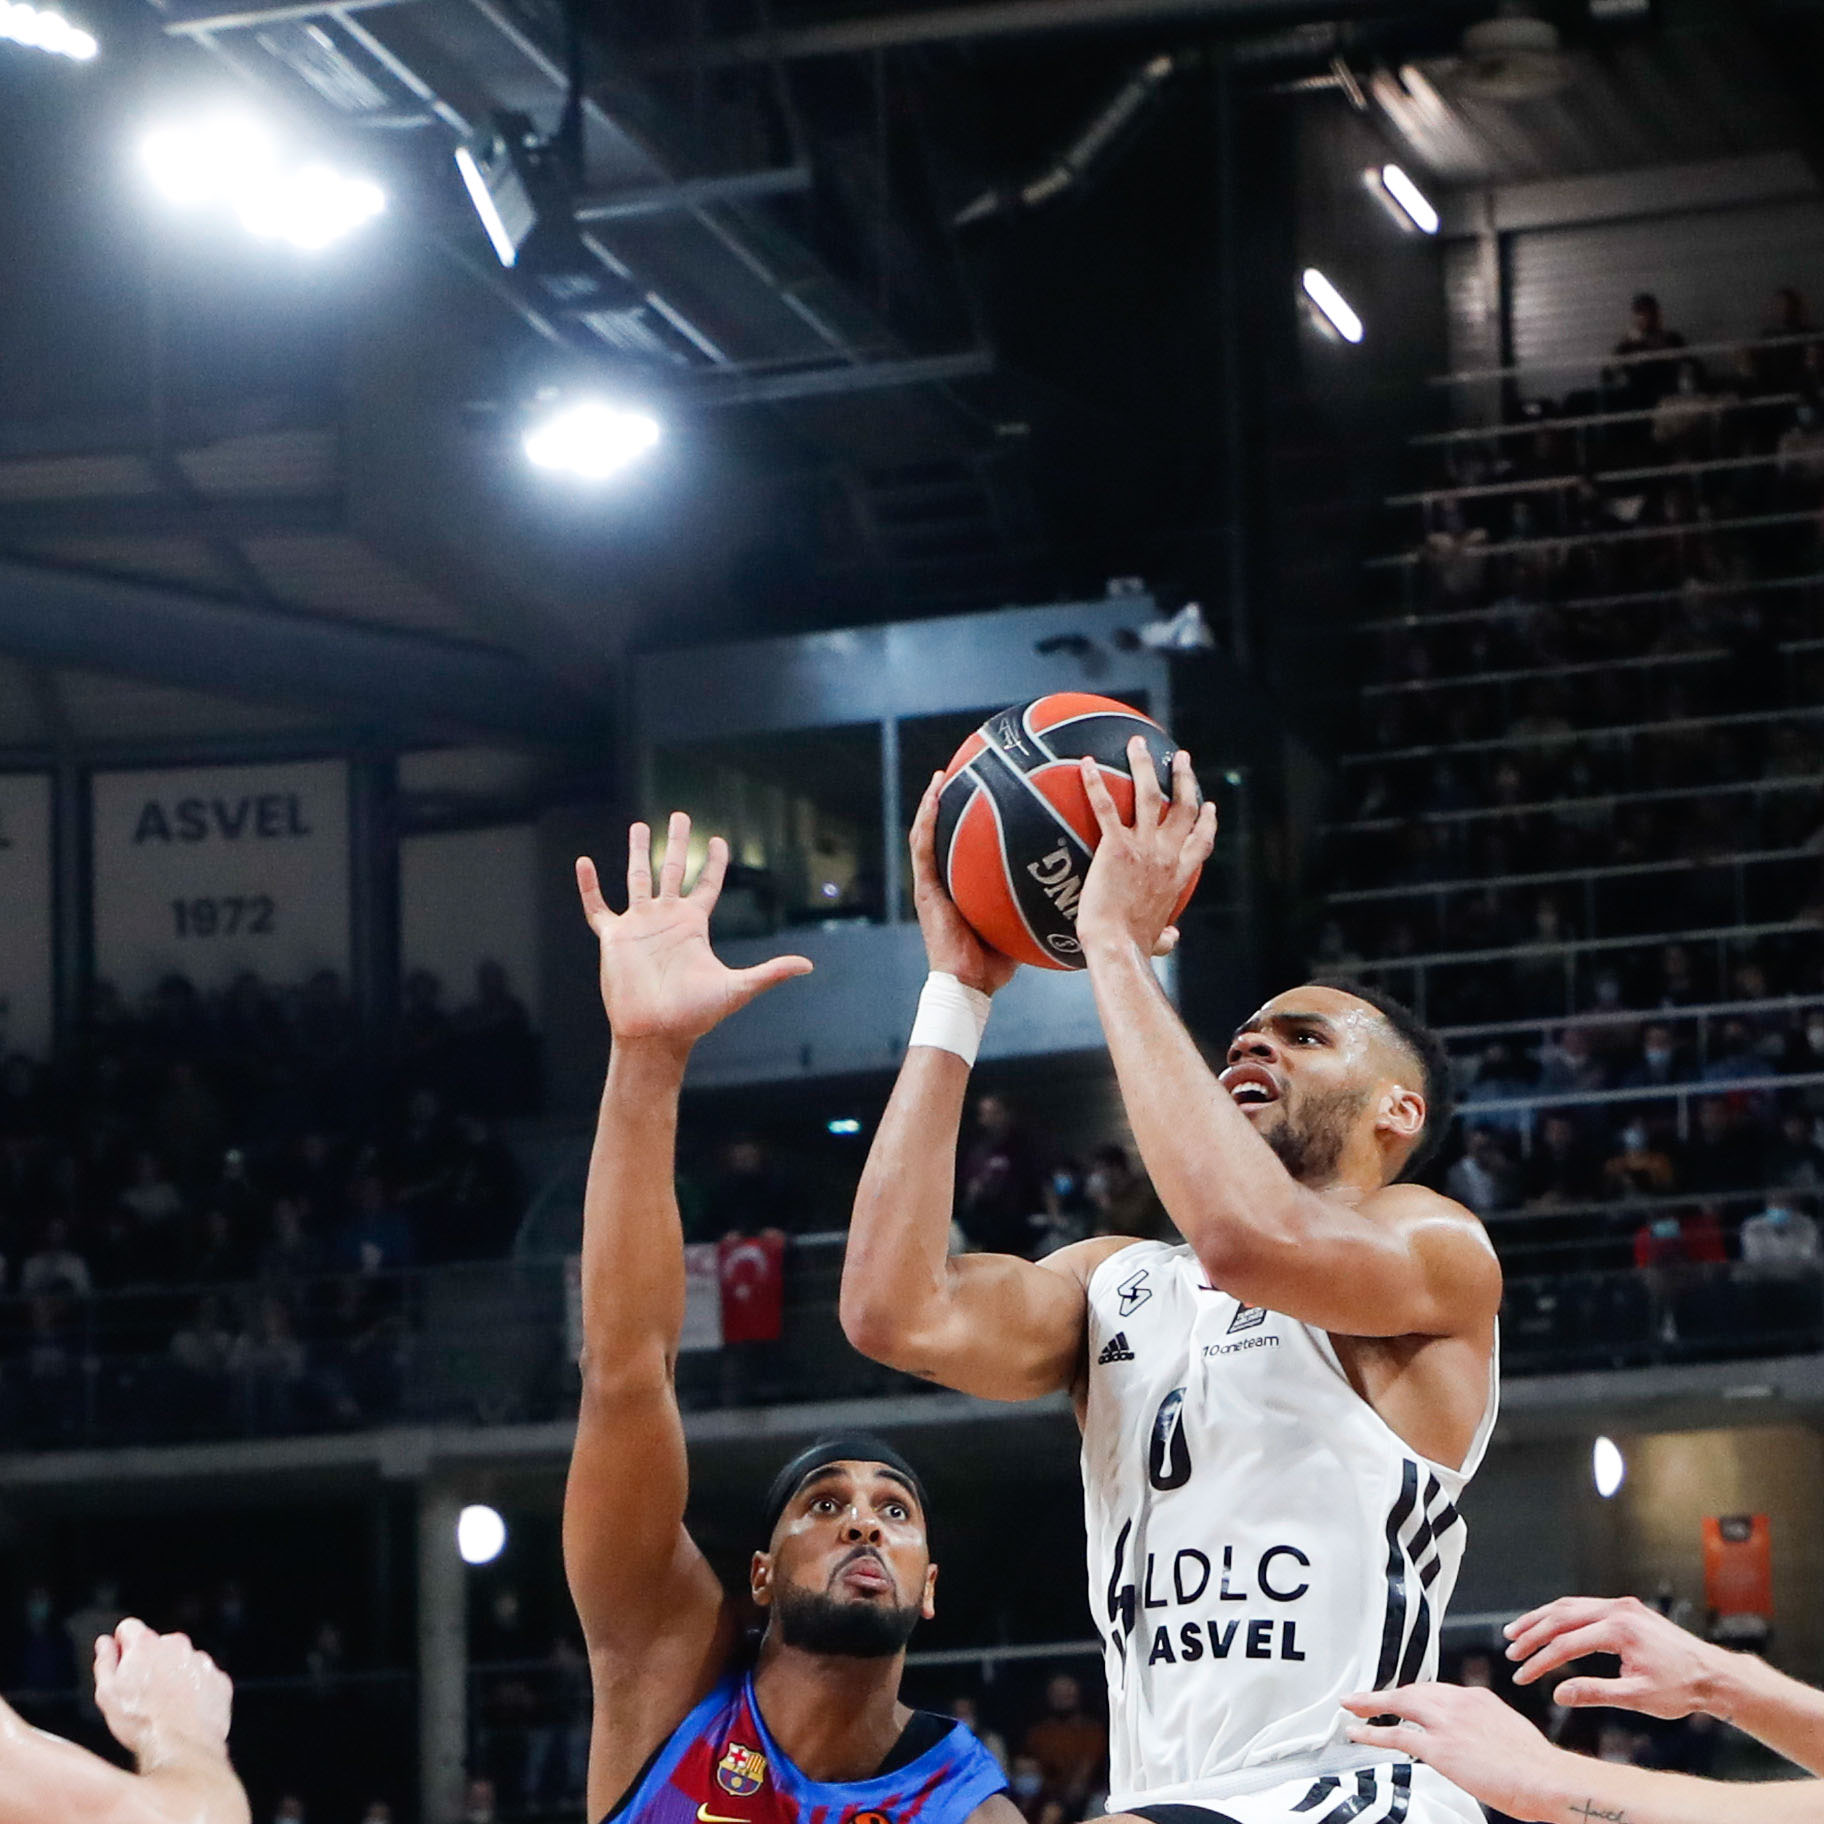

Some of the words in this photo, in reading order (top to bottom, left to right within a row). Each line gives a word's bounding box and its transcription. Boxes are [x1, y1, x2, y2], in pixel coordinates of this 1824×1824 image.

[130, 791, 311, 846] ASVEL
[170, 895, 277, 938] 1972
[1148, 1386, 1192, 1491] 0
[1143, 1544, 1311, 1609] LDLC
[1148, 1619, 1306, 1667] ASVEL
